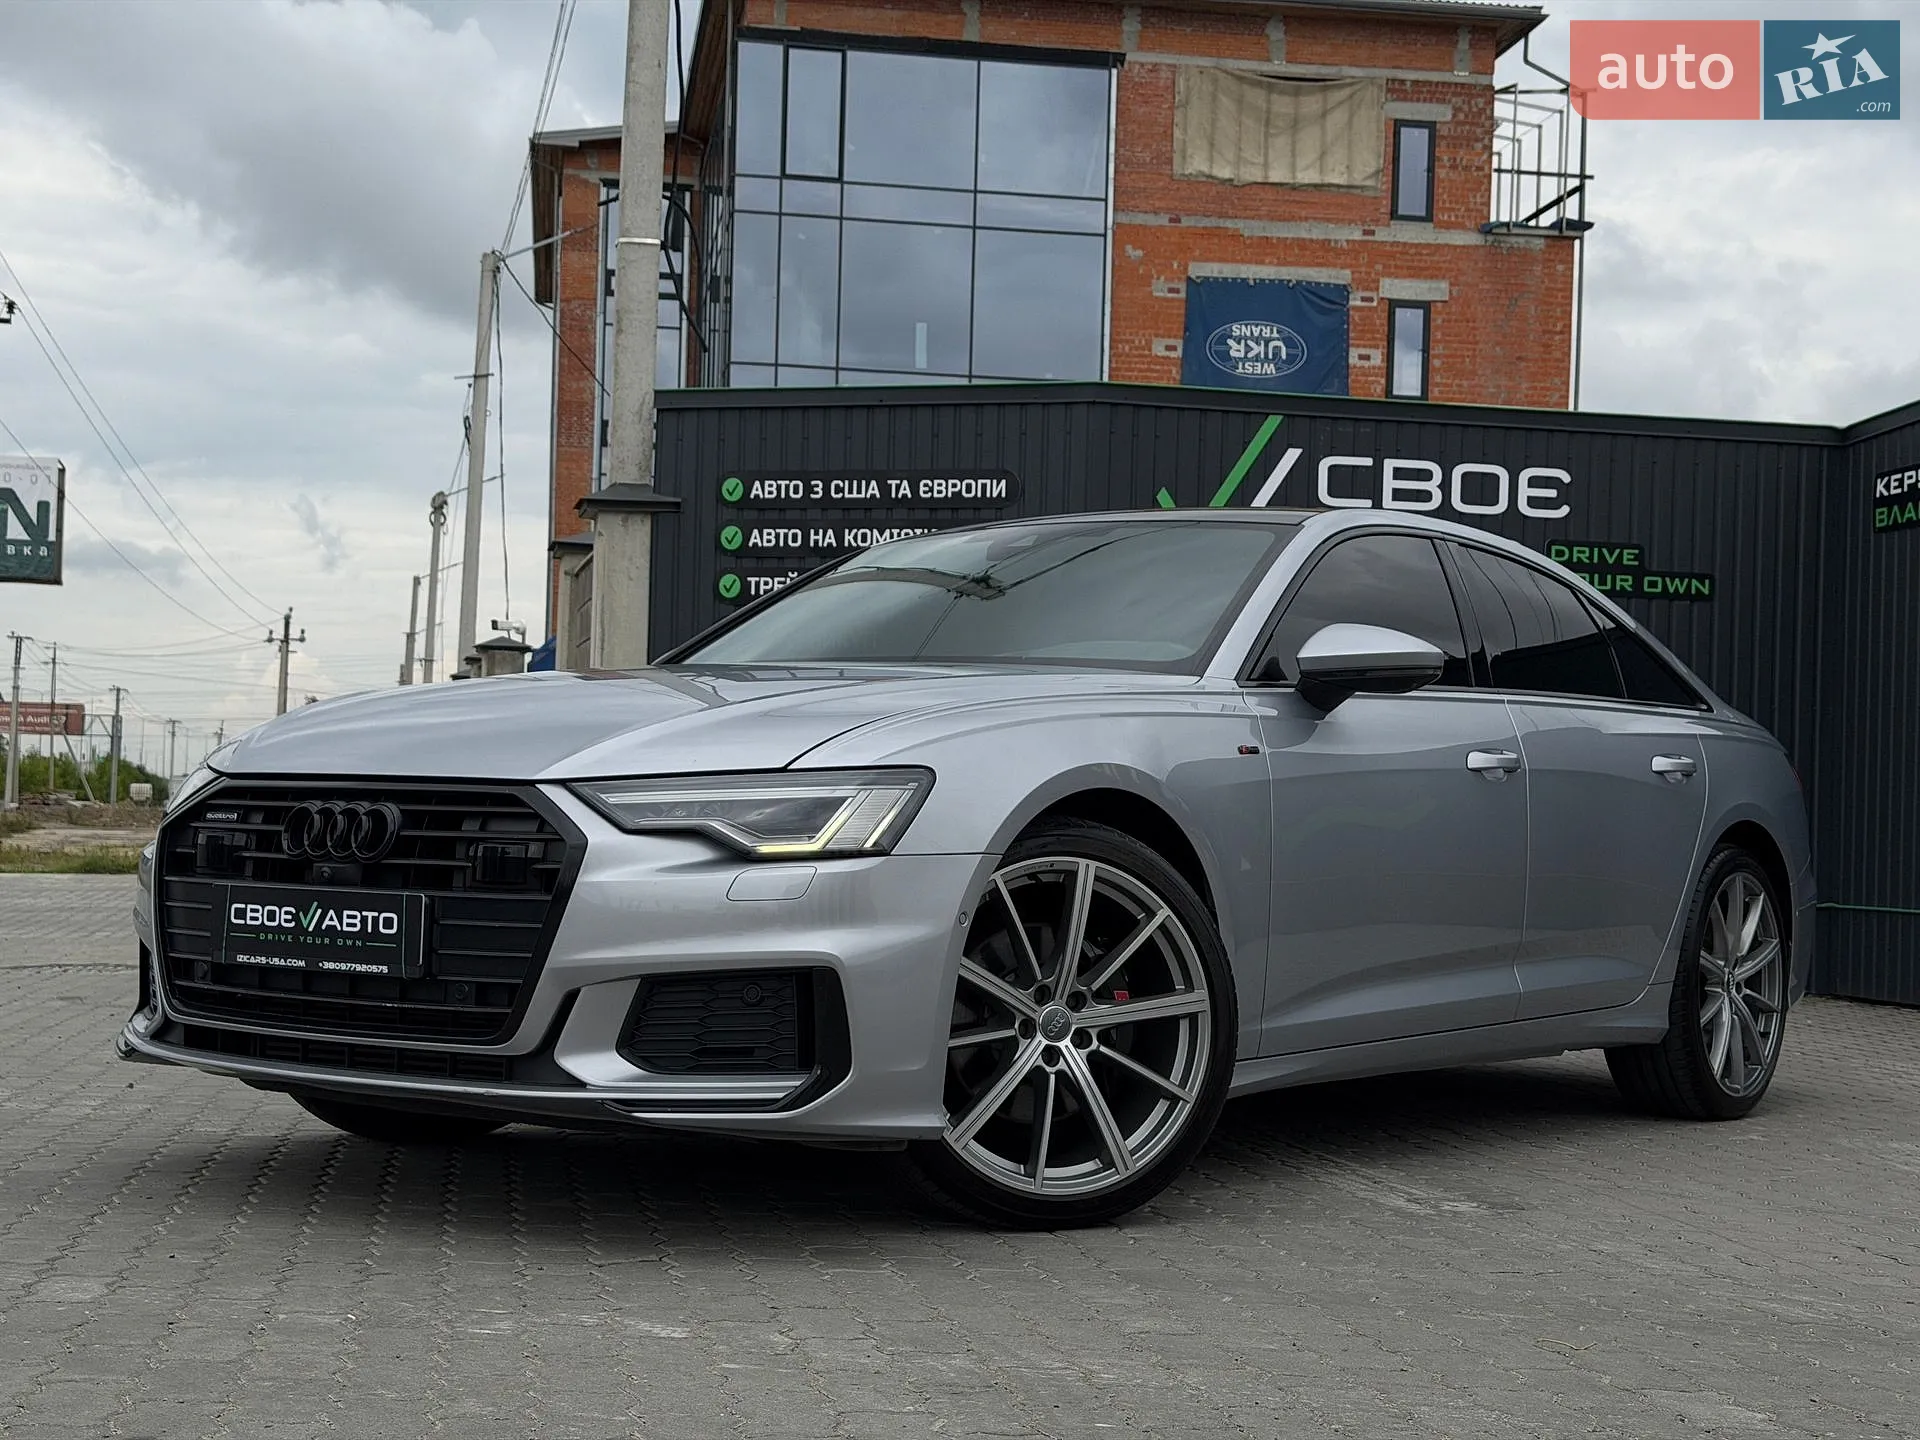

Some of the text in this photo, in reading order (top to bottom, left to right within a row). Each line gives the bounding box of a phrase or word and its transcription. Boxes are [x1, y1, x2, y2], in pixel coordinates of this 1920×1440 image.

[1231, 324, 1280, 337] TRANS
[1226, 338, 1286, 360] UKR
[1236, 361, 1276, 374] WEST
[750, 480, 803, 499] АВТО
[830, 480, 881, 499] США
[887, 479, 912, 498] ТА
[919, 479, 1007, 498] ЄВРОПИ
[1317, 455, 1572, 519] СВОЄ
[1875, 469, 1920, 498] КЕР
[1875, 500, 1920, 528] ВЛА
[748, 529, 801, 548] АВТО
[810, 529, 837, 548] НА
[1551, 545, 1640, 566] DRIVE
[1643, 576, 1709, 595] OWN
[230, 903, 398, 935] СВОЄ АВТО
[259, 933, 362, 947] DRIVE YOUR OWN
